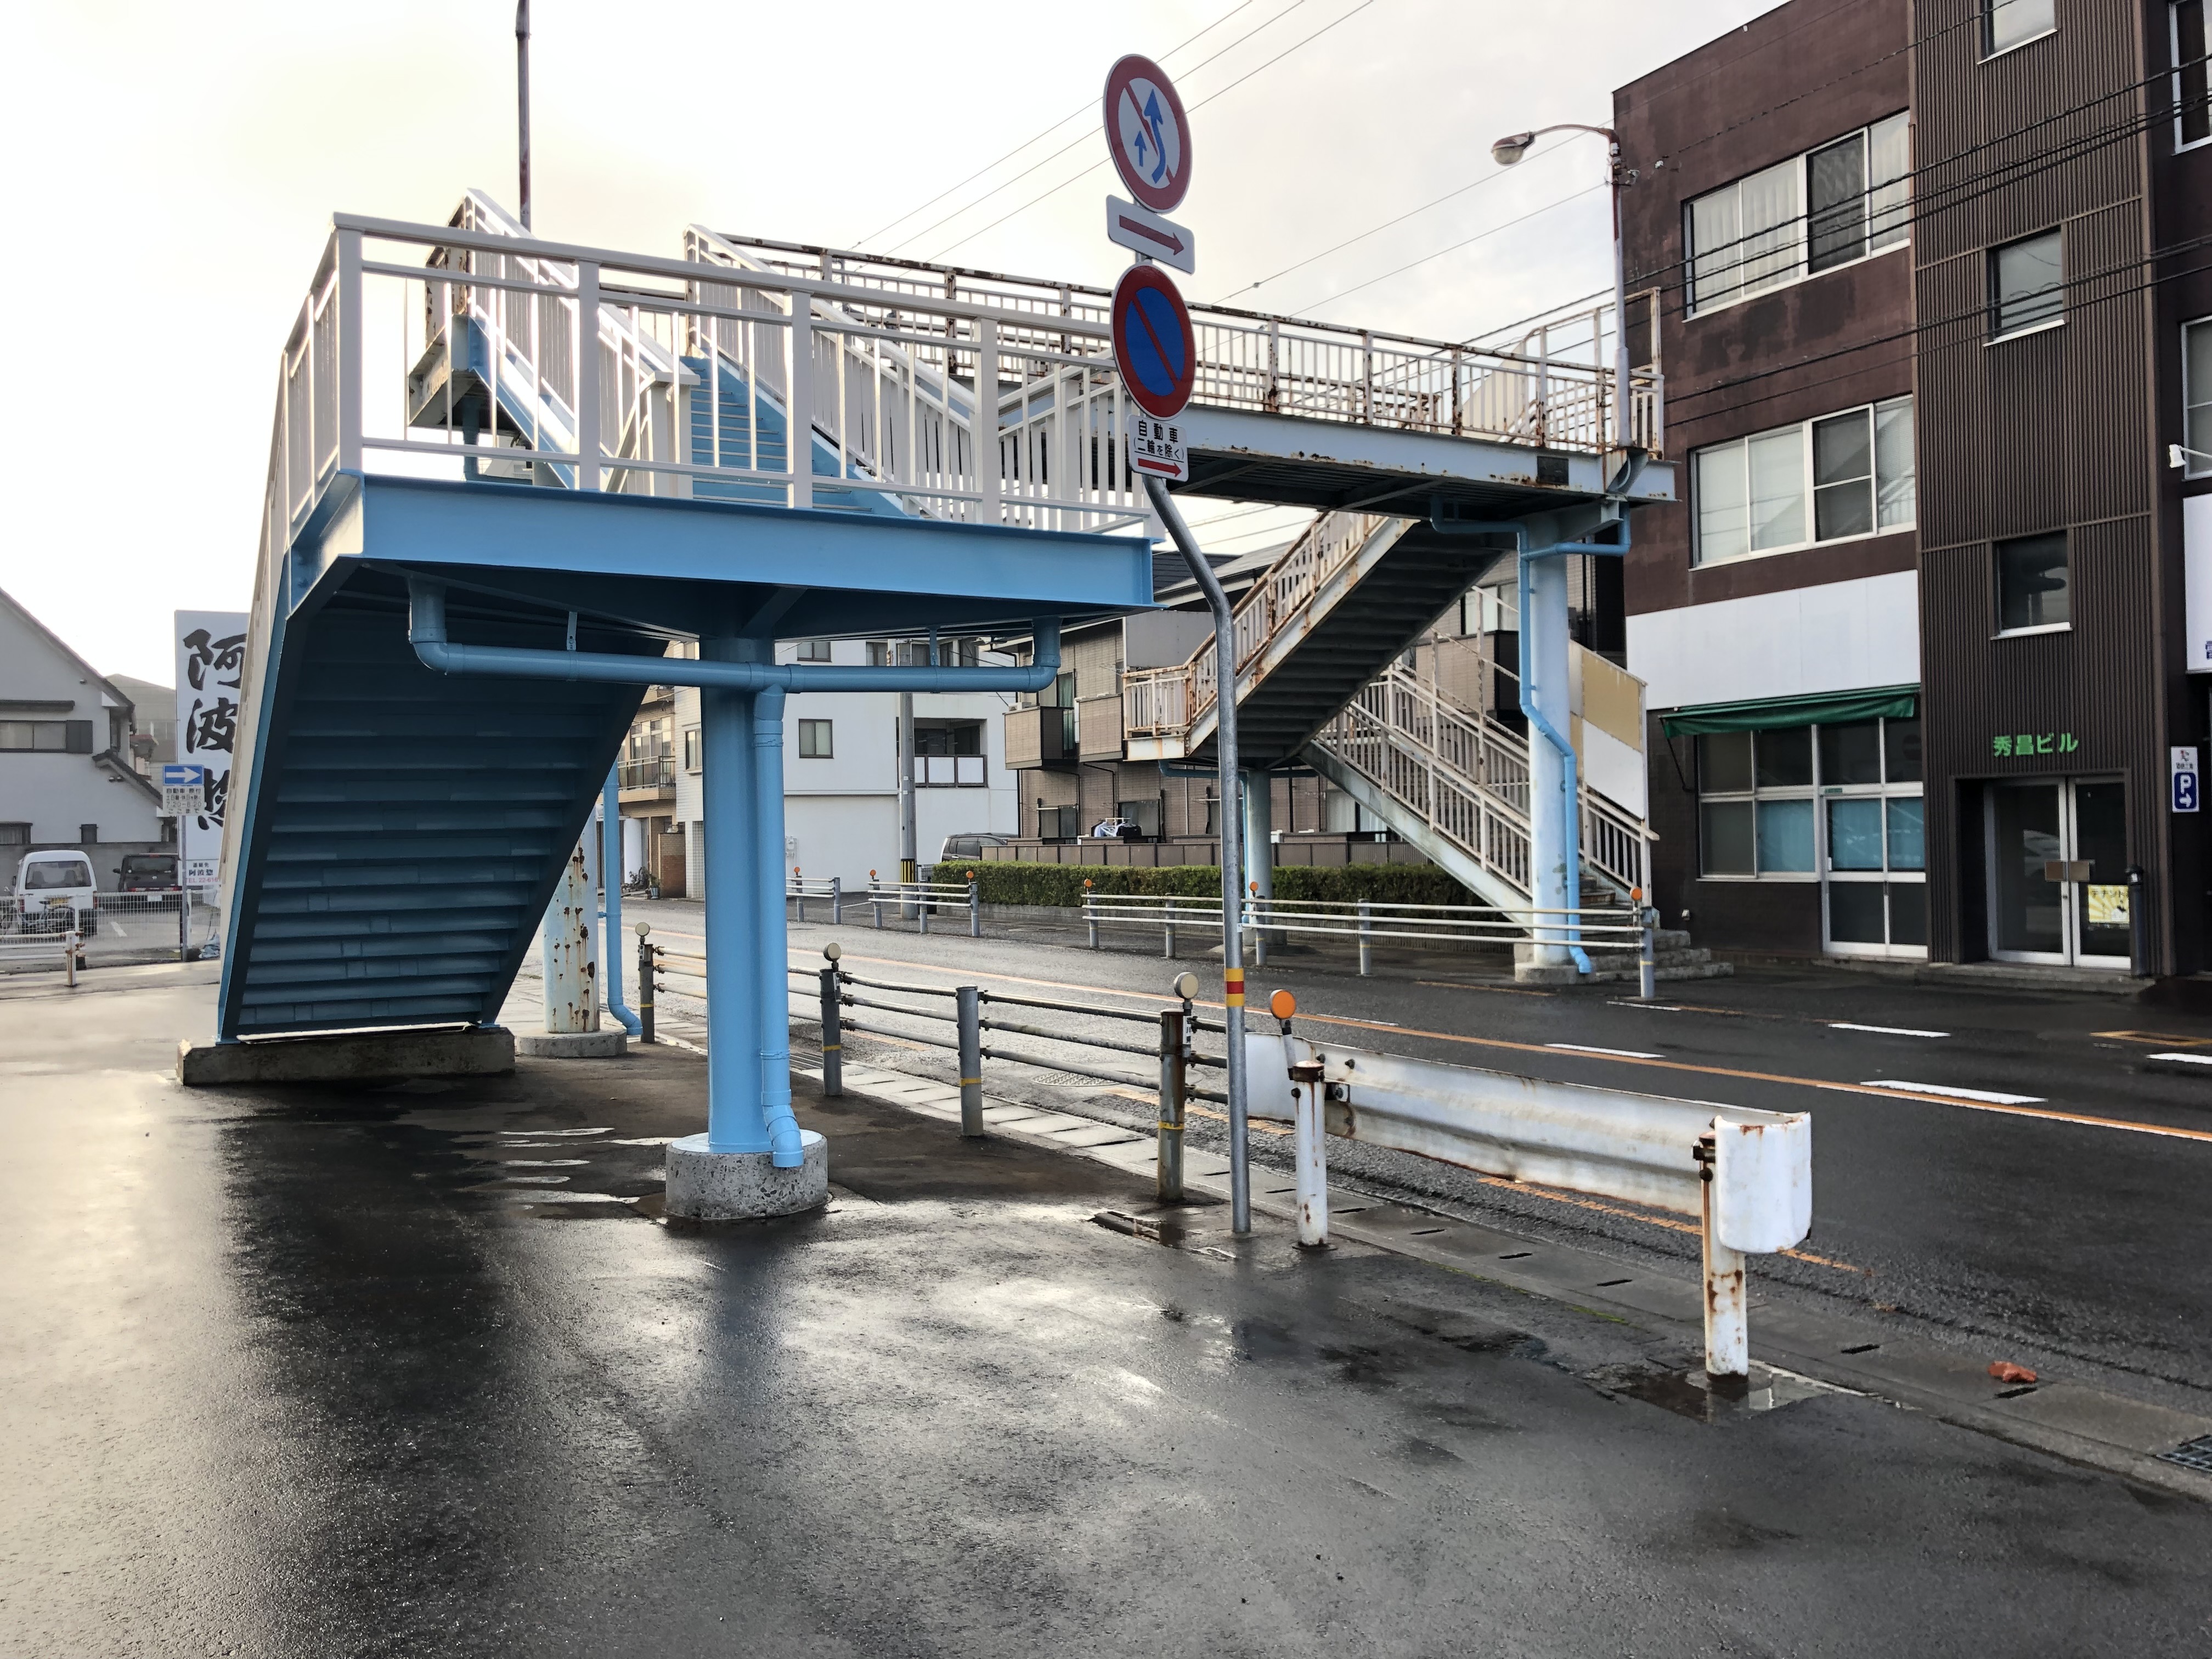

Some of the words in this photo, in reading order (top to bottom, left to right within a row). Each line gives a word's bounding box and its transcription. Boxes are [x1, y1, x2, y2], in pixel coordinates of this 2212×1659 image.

[1138, 420, 1178, 444] 自動車
[1993, 732, 2079, 757] 秀昌ビル
[2180, 774, 2192, 794] P
